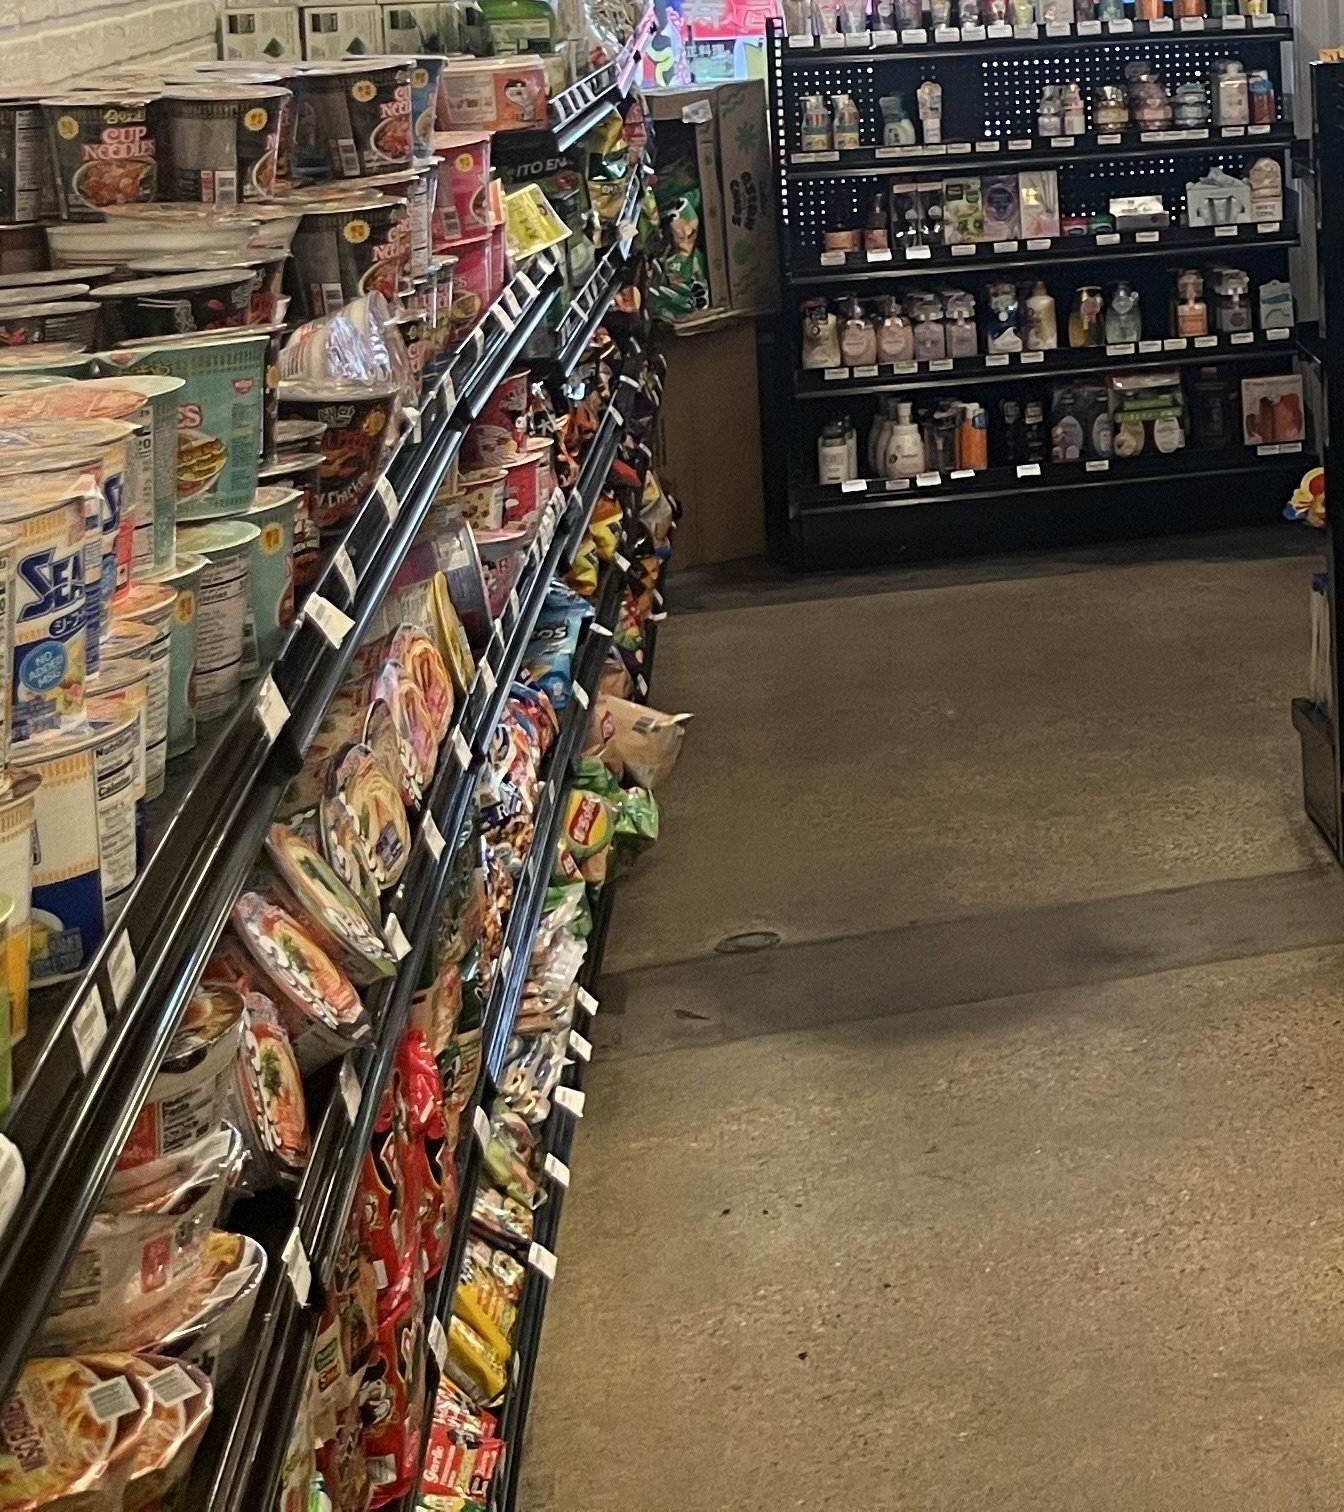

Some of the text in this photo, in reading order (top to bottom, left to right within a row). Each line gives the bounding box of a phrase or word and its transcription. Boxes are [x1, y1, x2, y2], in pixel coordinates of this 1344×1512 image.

[103, 125, 147, 144] CUP
[80, 139, 156, 160] NOODLES
[35, 651, 53, 666] NO
[28, 655, 64, 683] ADDED
